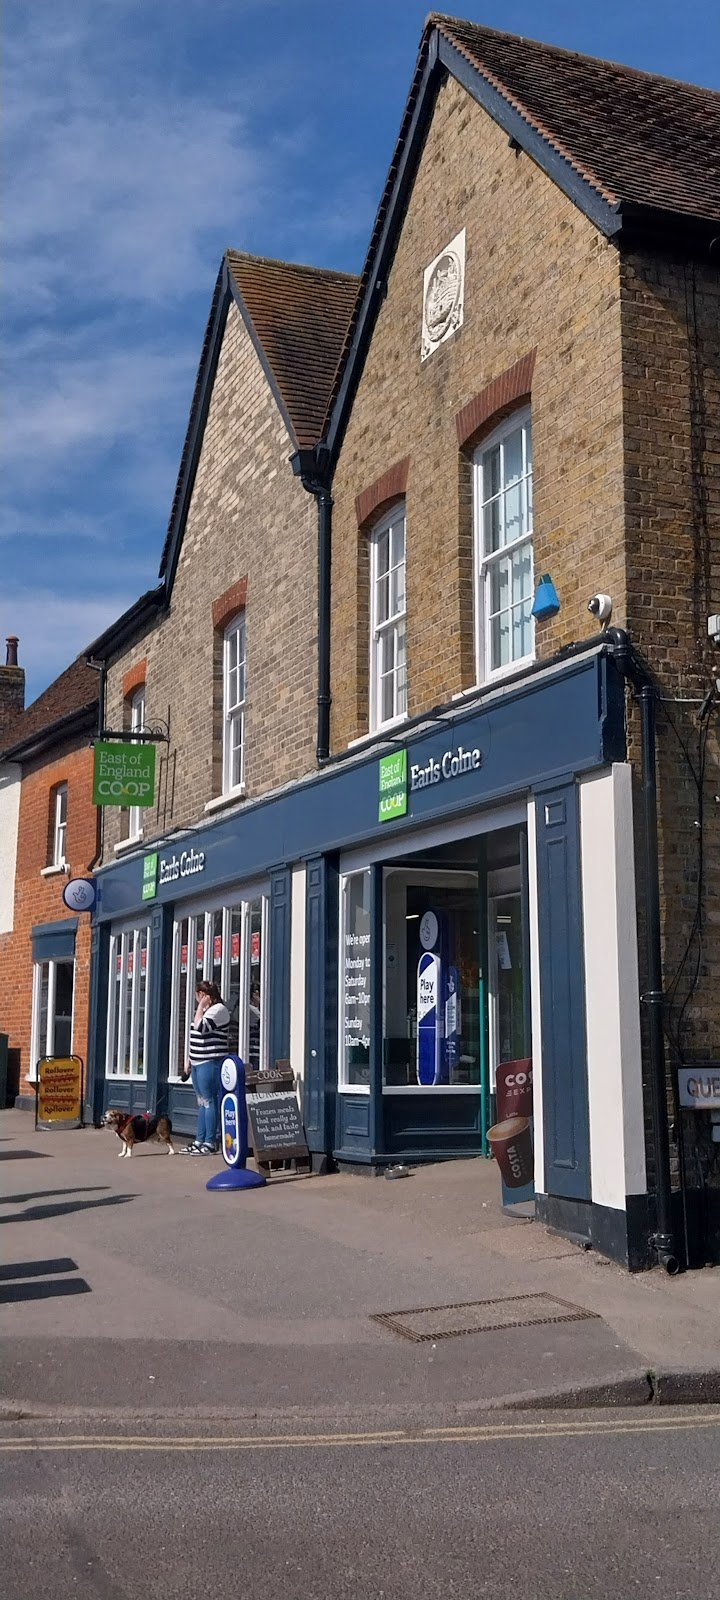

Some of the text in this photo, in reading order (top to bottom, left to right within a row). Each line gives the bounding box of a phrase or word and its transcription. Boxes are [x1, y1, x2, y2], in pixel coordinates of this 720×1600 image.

[99, 751, 144, 765] East of
[99, 764, 150, 780] England
[381, 758, 401, 779] East of
[410, 747, 481, 791] Earls Colne
[381, 771, 404, 794] England
[159, 855, 180, 884] Earls
[180, 848, 205, 877] Colne
[345, 933, 359, 946] We're
[345, 957, 365, 970] Monday
[345, 974, 367, 988] Saturday
[420, 979, 434, 993] Play
[420, 993, 434, 1004] here
[345, 1016, 363, 1031] Sunday
[257, 1070, 283, 1080] COOK
[44, 1106, 75, 1114] Rollover
[225, 1109, 235, 1120] Play
[270, 1115, 289, 1124] really
[290, 1113, 298, 1121] do
[257, 1122, 299, 1133] look and taste
[507, 1145, 522, 1178] COSTA
